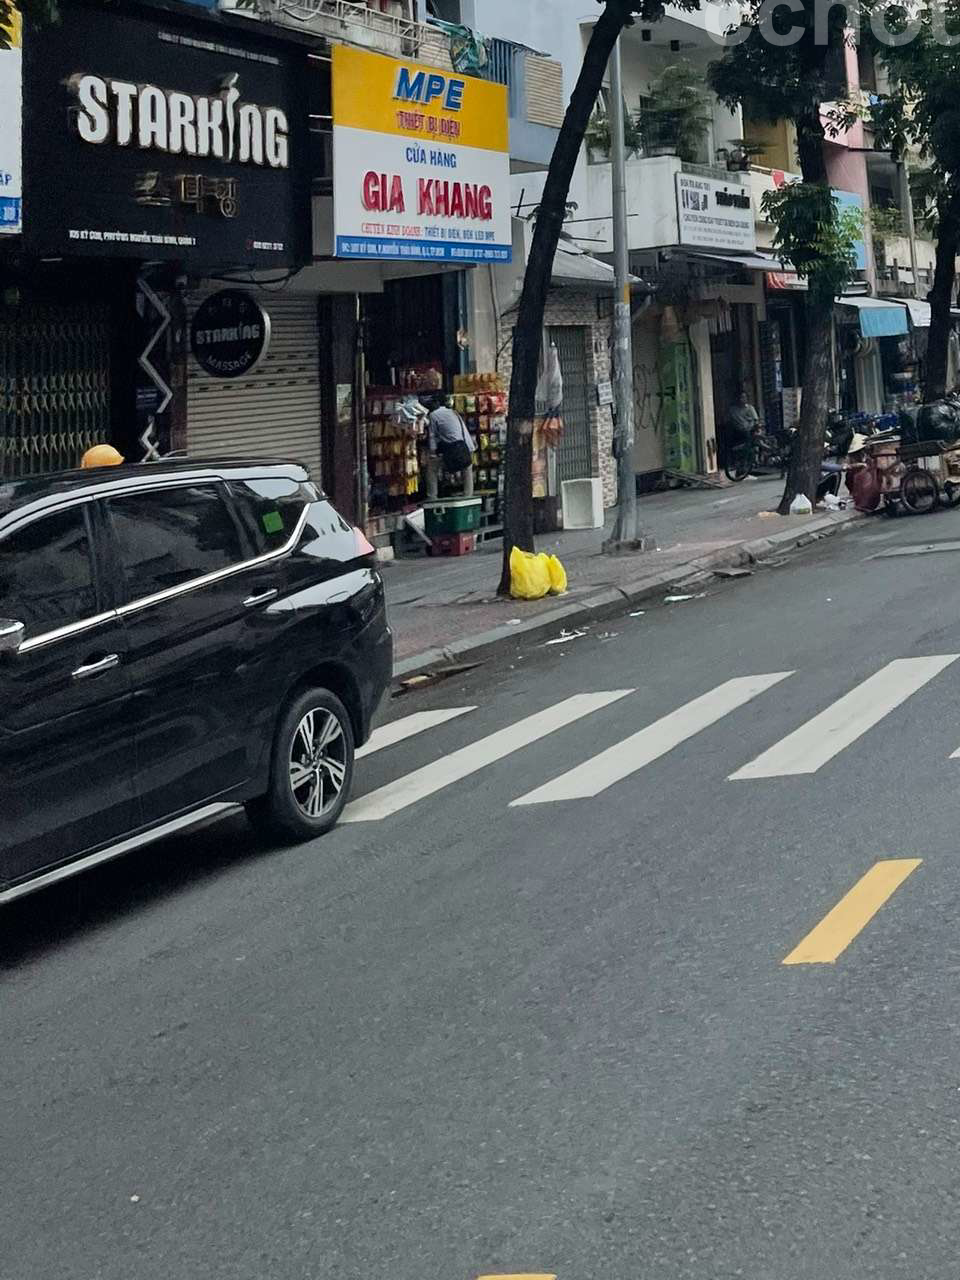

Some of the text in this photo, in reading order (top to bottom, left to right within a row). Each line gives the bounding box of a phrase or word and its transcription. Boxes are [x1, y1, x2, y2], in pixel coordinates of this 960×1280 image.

[394, 67, 464, 112] MPE
[77, 72, 289, 169] STARKING
[406, 142, 457, 168] CỬA HÀNG
[362, 171, 493, 220] GIA KHANG
